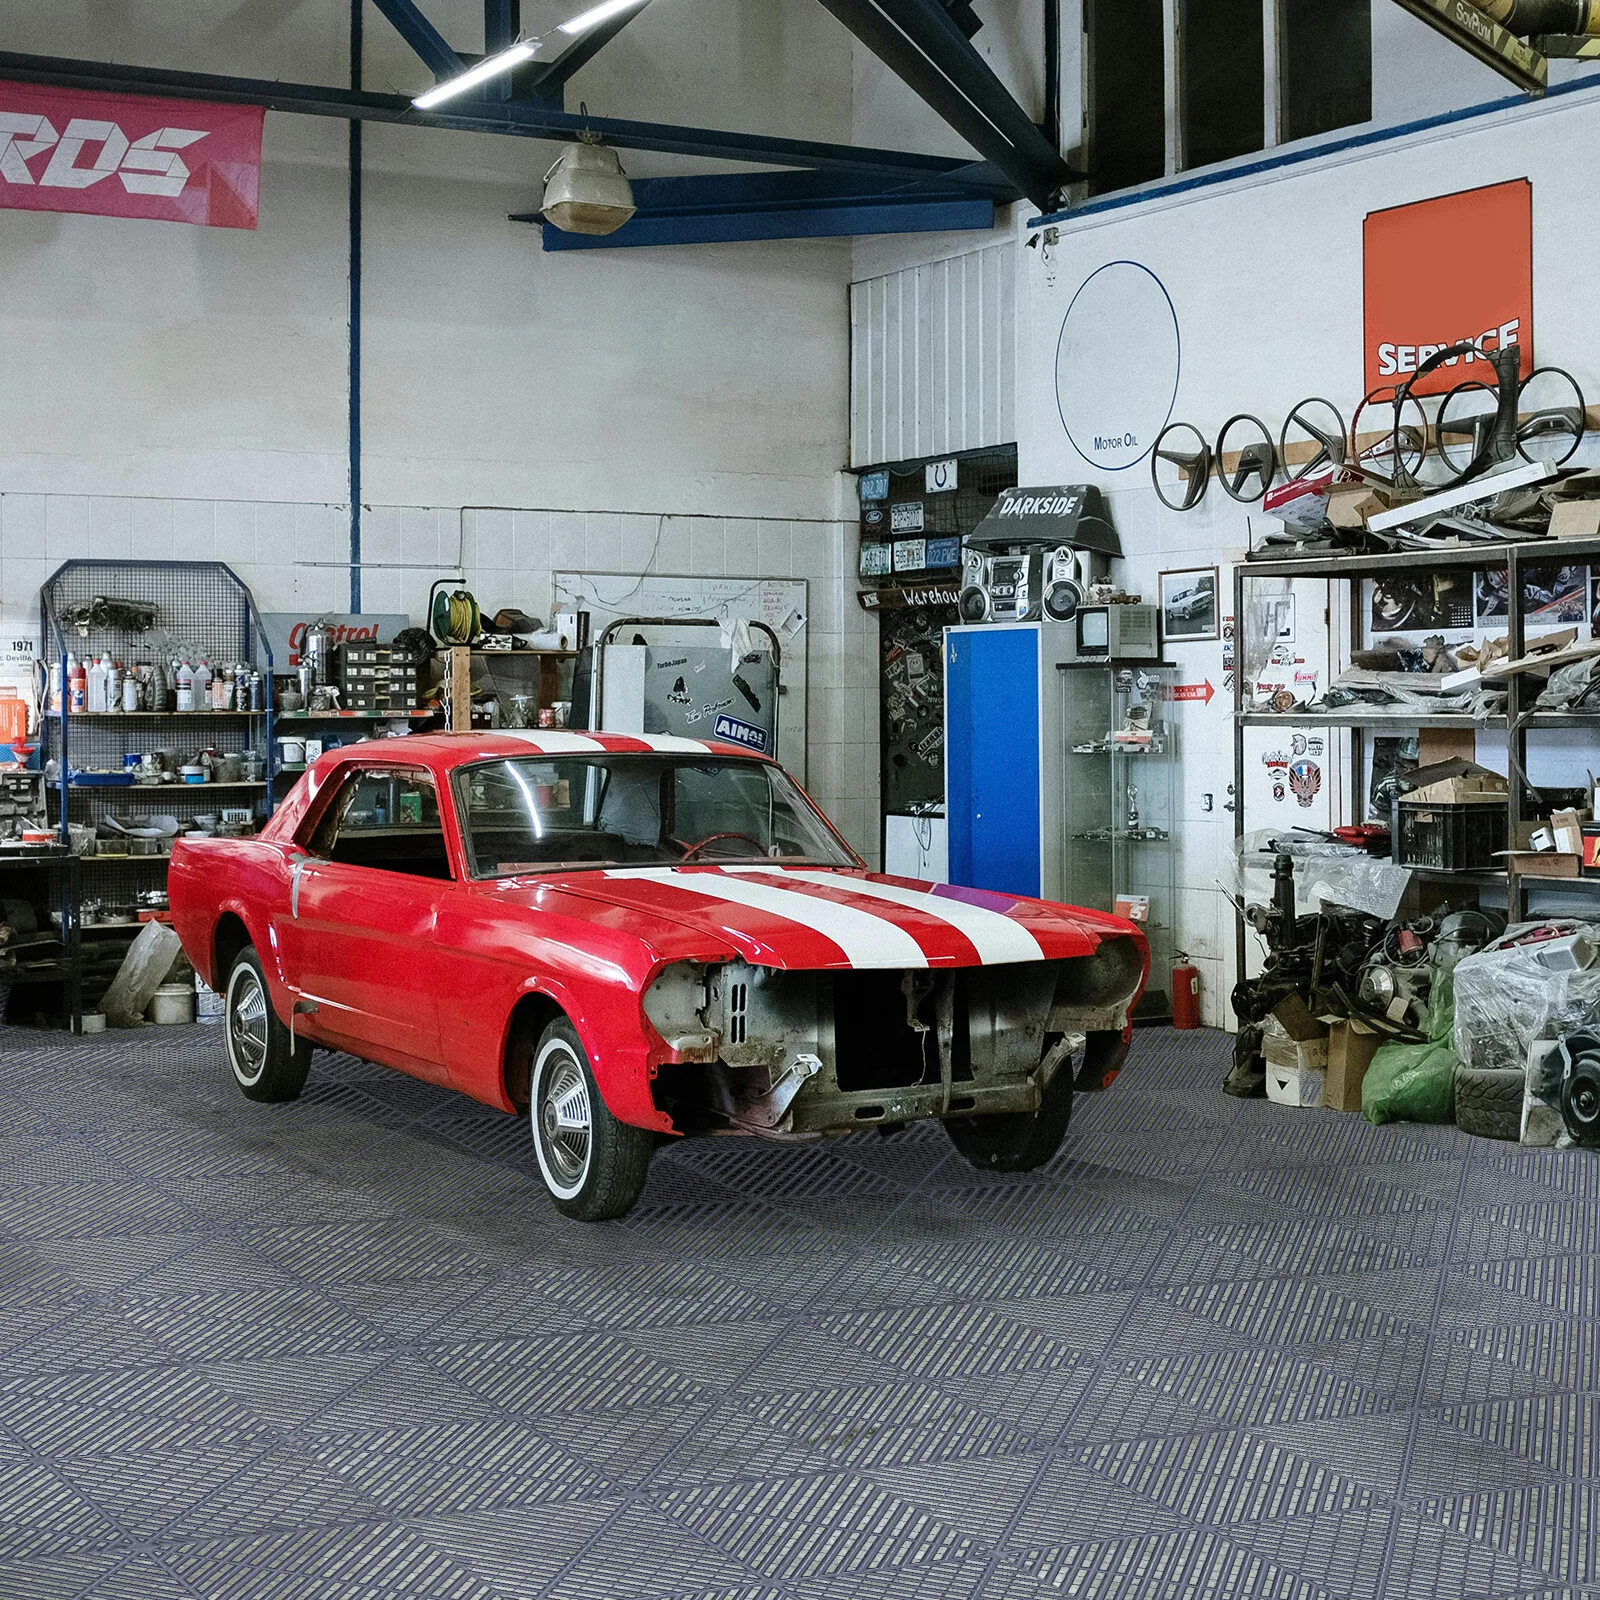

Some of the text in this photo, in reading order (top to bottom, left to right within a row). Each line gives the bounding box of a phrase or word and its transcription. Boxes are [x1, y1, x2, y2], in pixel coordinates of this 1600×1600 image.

[0, 112, 211, 197] RDS
[1094, 433, 1138, 450] MOTOR OIL
[1000, 496, 1079, 515] DARKSIDE
[288, 622, 379, 650] Ctrol
[12, 641, 33, 652] 1971
